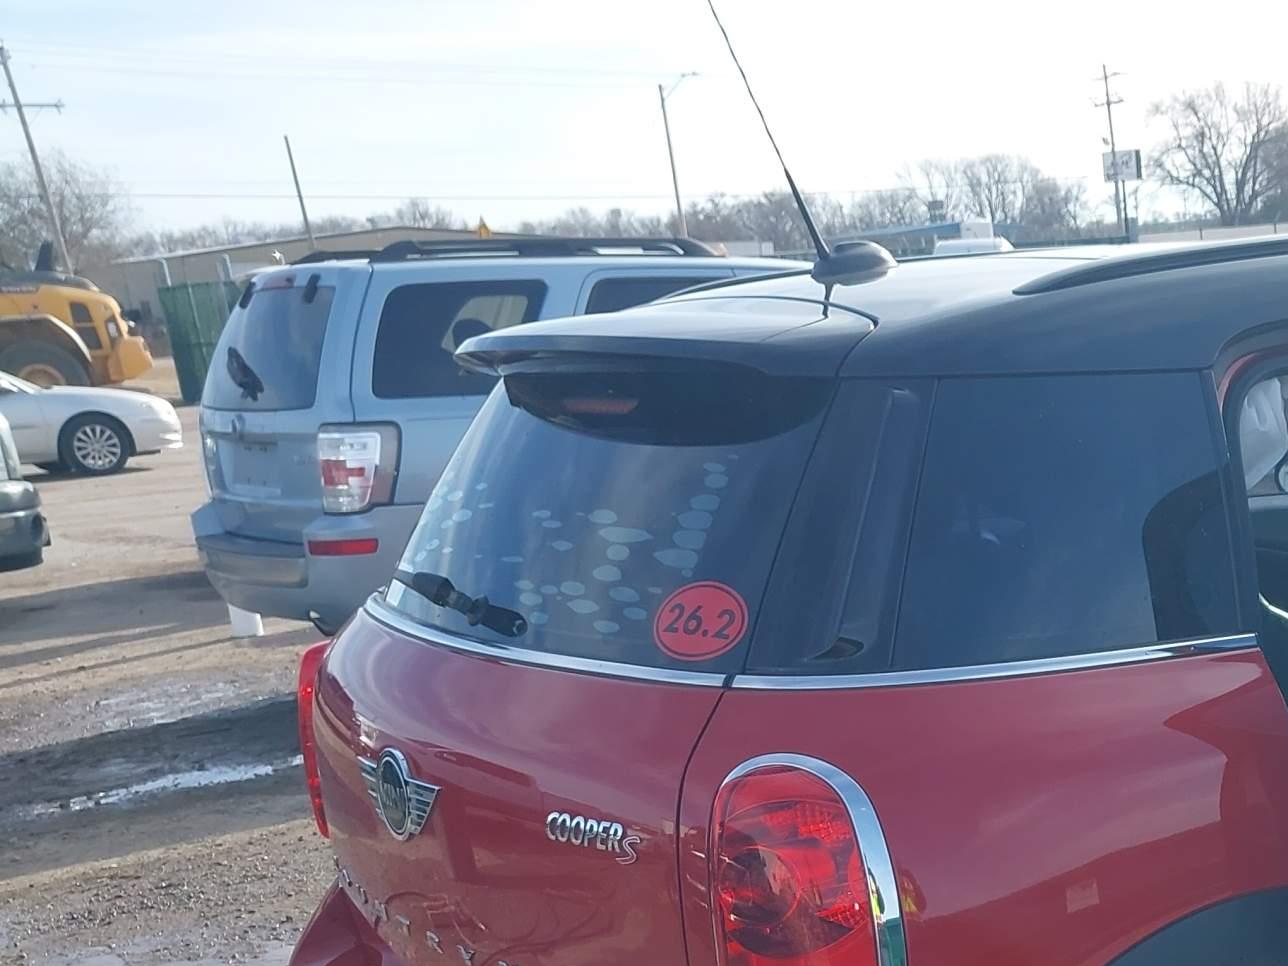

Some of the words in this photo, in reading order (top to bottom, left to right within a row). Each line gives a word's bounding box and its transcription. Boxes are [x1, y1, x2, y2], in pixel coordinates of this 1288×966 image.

[662, 602, 736, 640] 26.2
[546, 811, 624, 853] COOPER
[615, 836, 641, 865] S
